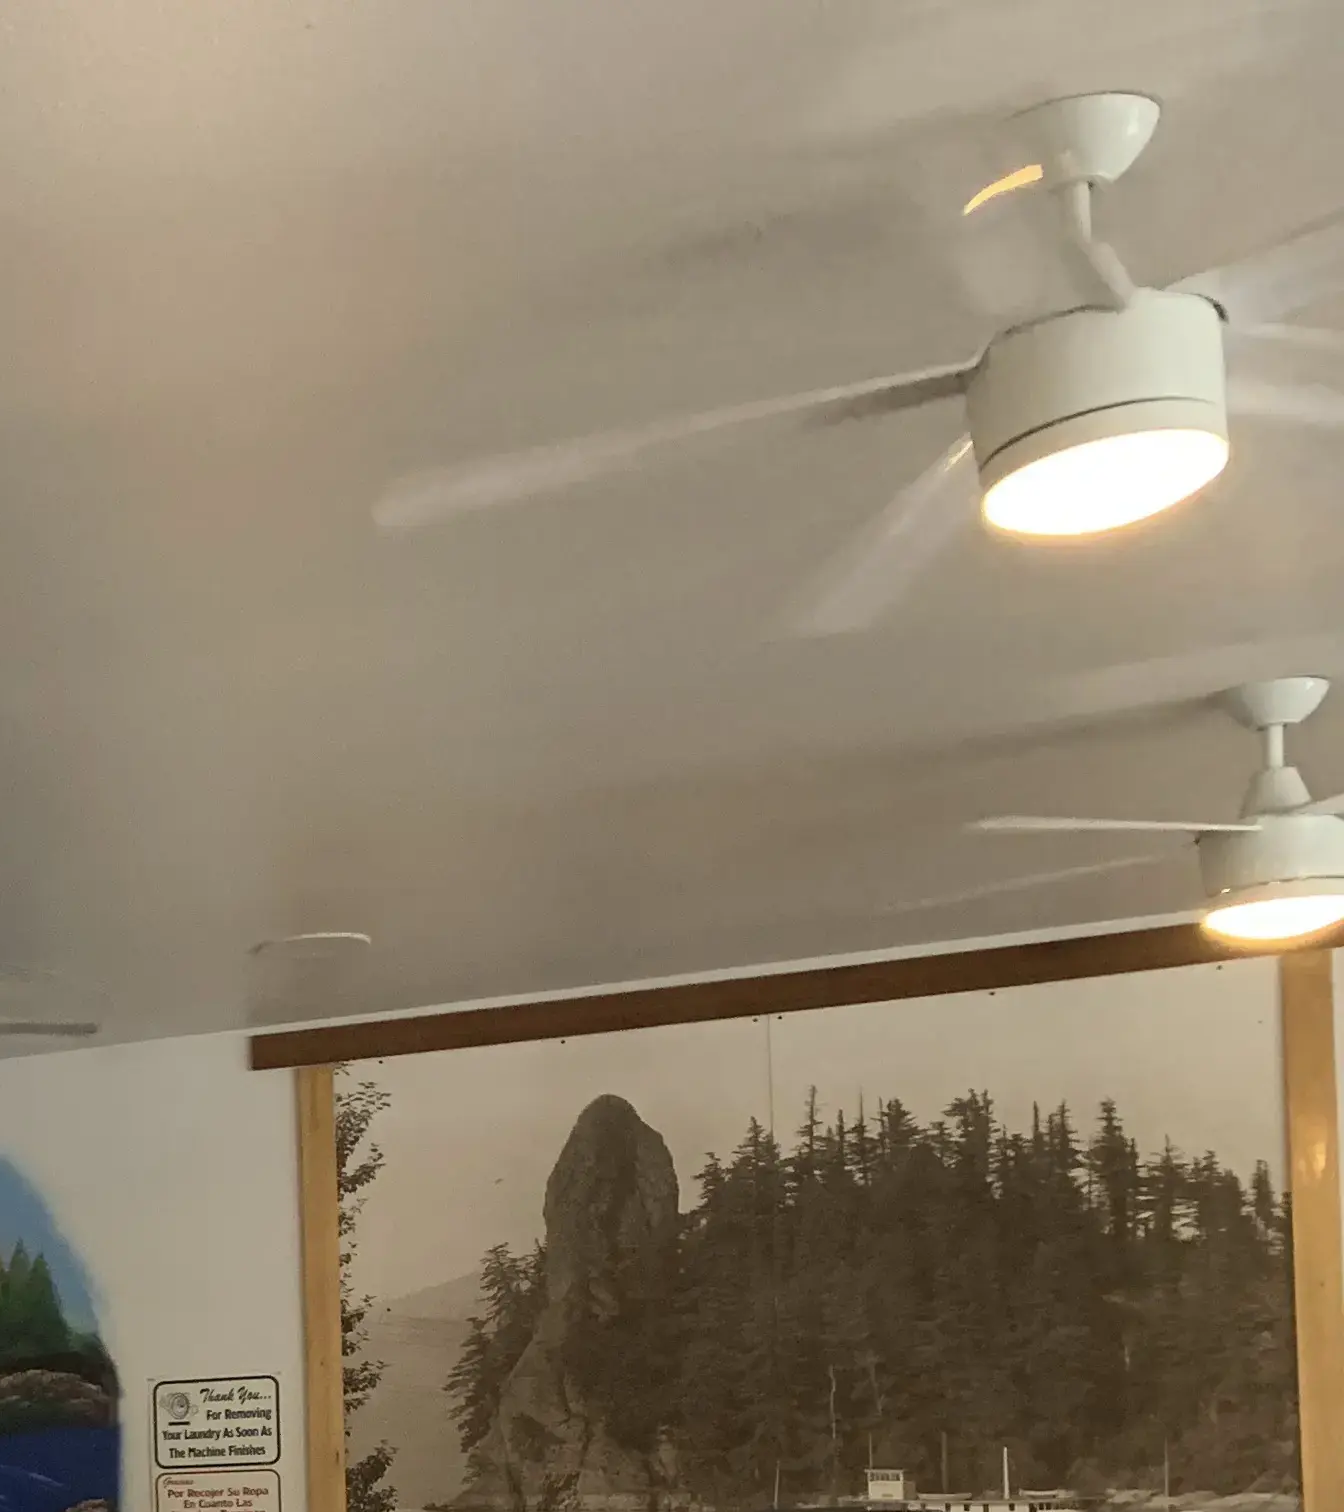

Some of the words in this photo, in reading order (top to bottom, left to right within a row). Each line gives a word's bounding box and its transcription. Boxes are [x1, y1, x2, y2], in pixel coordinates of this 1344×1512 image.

[200, 1388, 234, 1403] Thank
[206, 1410, 222, 1420] For
[224, 1407, 272, 1420] Removing
[162, 1430, 182, 1440] Your
[184, 1428, 222, 1440] Laundry
[223, 1427, 234, 1438] As
[235, 1427, 259, 1438] Soon
[261, 1426, 272, 1437] As
[169, 1448, 185, 1458] The
[188, 1446, 226, 1458] Machine
[228, 1444, 266, 1456] Finishes
[167, 1489, 183, 1498] Por
